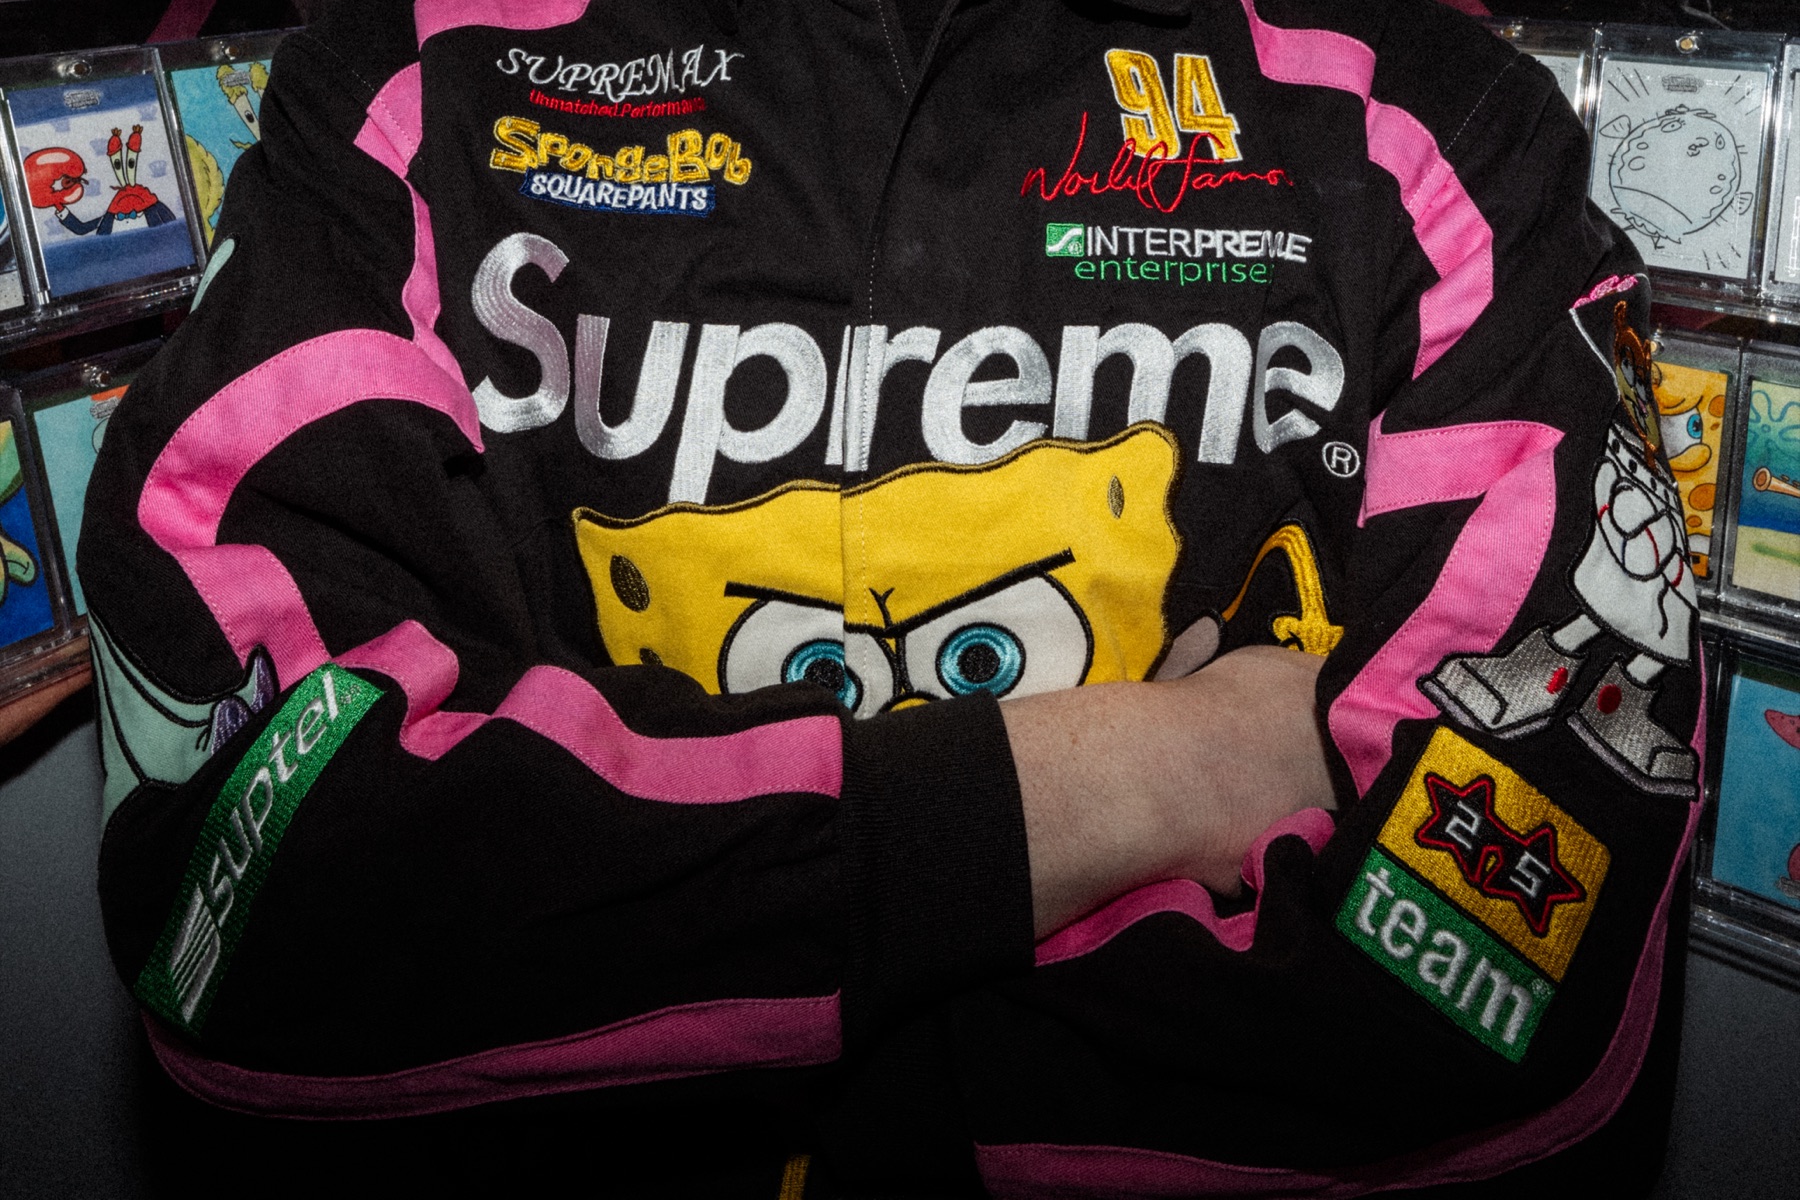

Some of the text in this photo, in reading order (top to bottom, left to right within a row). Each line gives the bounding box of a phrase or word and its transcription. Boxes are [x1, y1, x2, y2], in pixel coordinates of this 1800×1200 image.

[497, 44, 745, 103] SUPREMAX
[621, 96, 705, 119] Performa
[1104, 48, 1243, 163] 94
[530, 172, 709, 211] SQUAREPANTS
[1074, 257, 1275, 287] enterprise
[472, 231, 1346, 505] Supreme
[1354, 867, 1534, 1046] team
